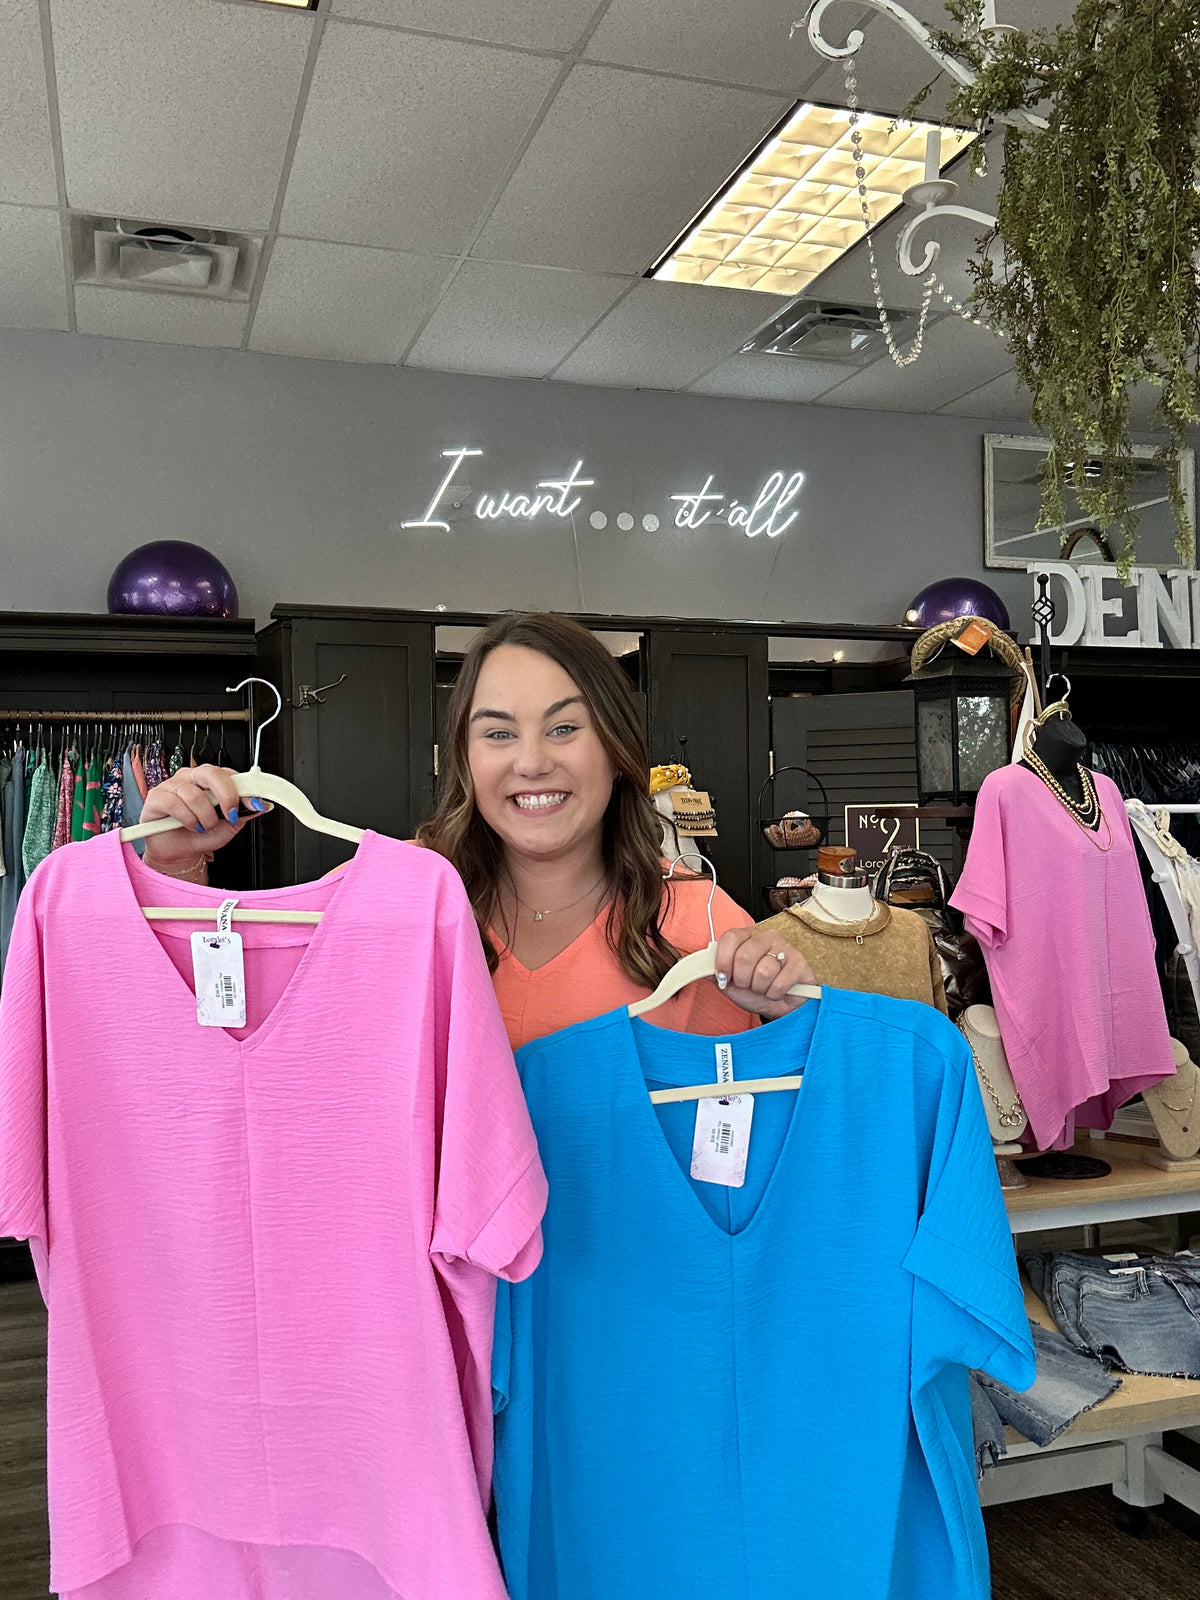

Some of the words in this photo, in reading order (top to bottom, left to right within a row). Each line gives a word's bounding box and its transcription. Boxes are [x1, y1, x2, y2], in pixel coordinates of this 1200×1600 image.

[400, 447, 483, 534] I
[475, 459, 595, 519] want
[670, 474, 724, 529] it
[727, 470, 805, 538] all
[720, 1048, 730, 1083] ZENANA
